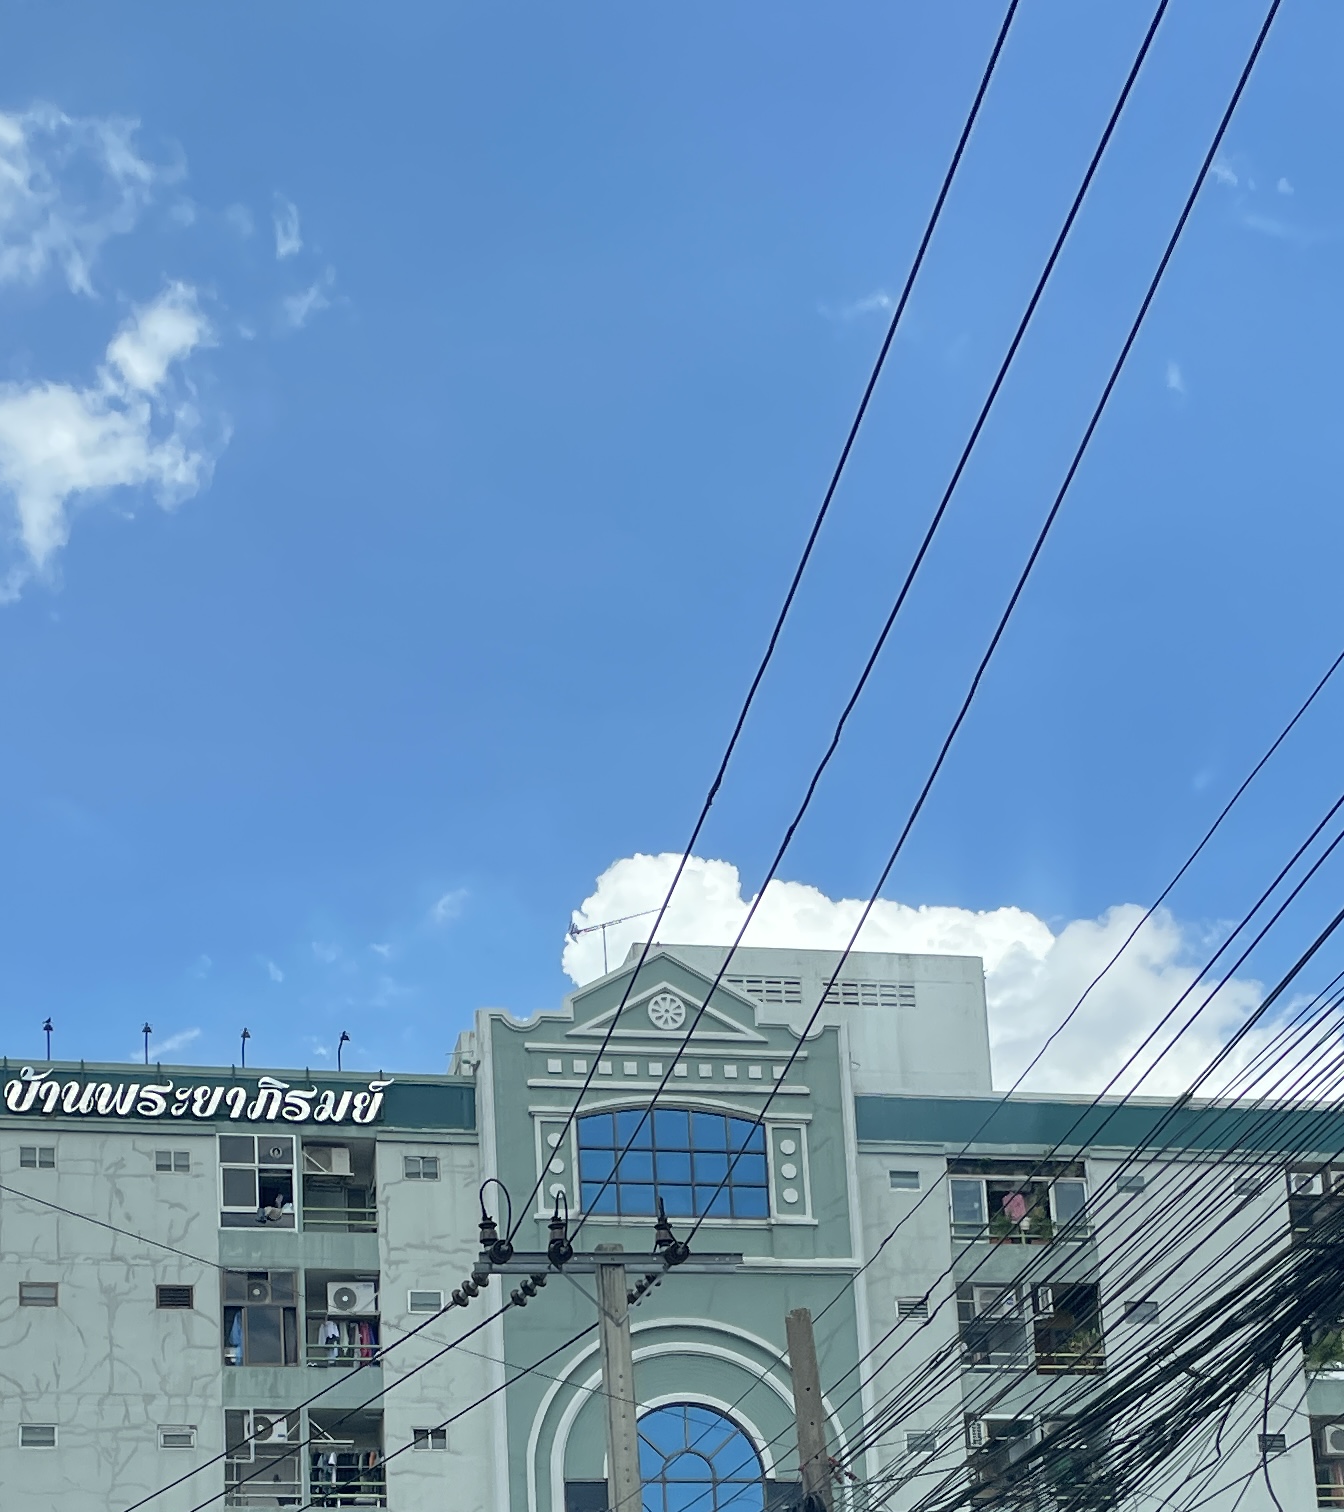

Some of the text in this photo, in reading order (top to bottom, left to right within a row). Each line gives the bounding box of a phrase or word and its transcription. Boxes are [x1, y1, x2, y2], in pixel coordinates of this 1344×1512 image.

[4, 1066, 394, 1124] บ้านพระยาภิรมย์
